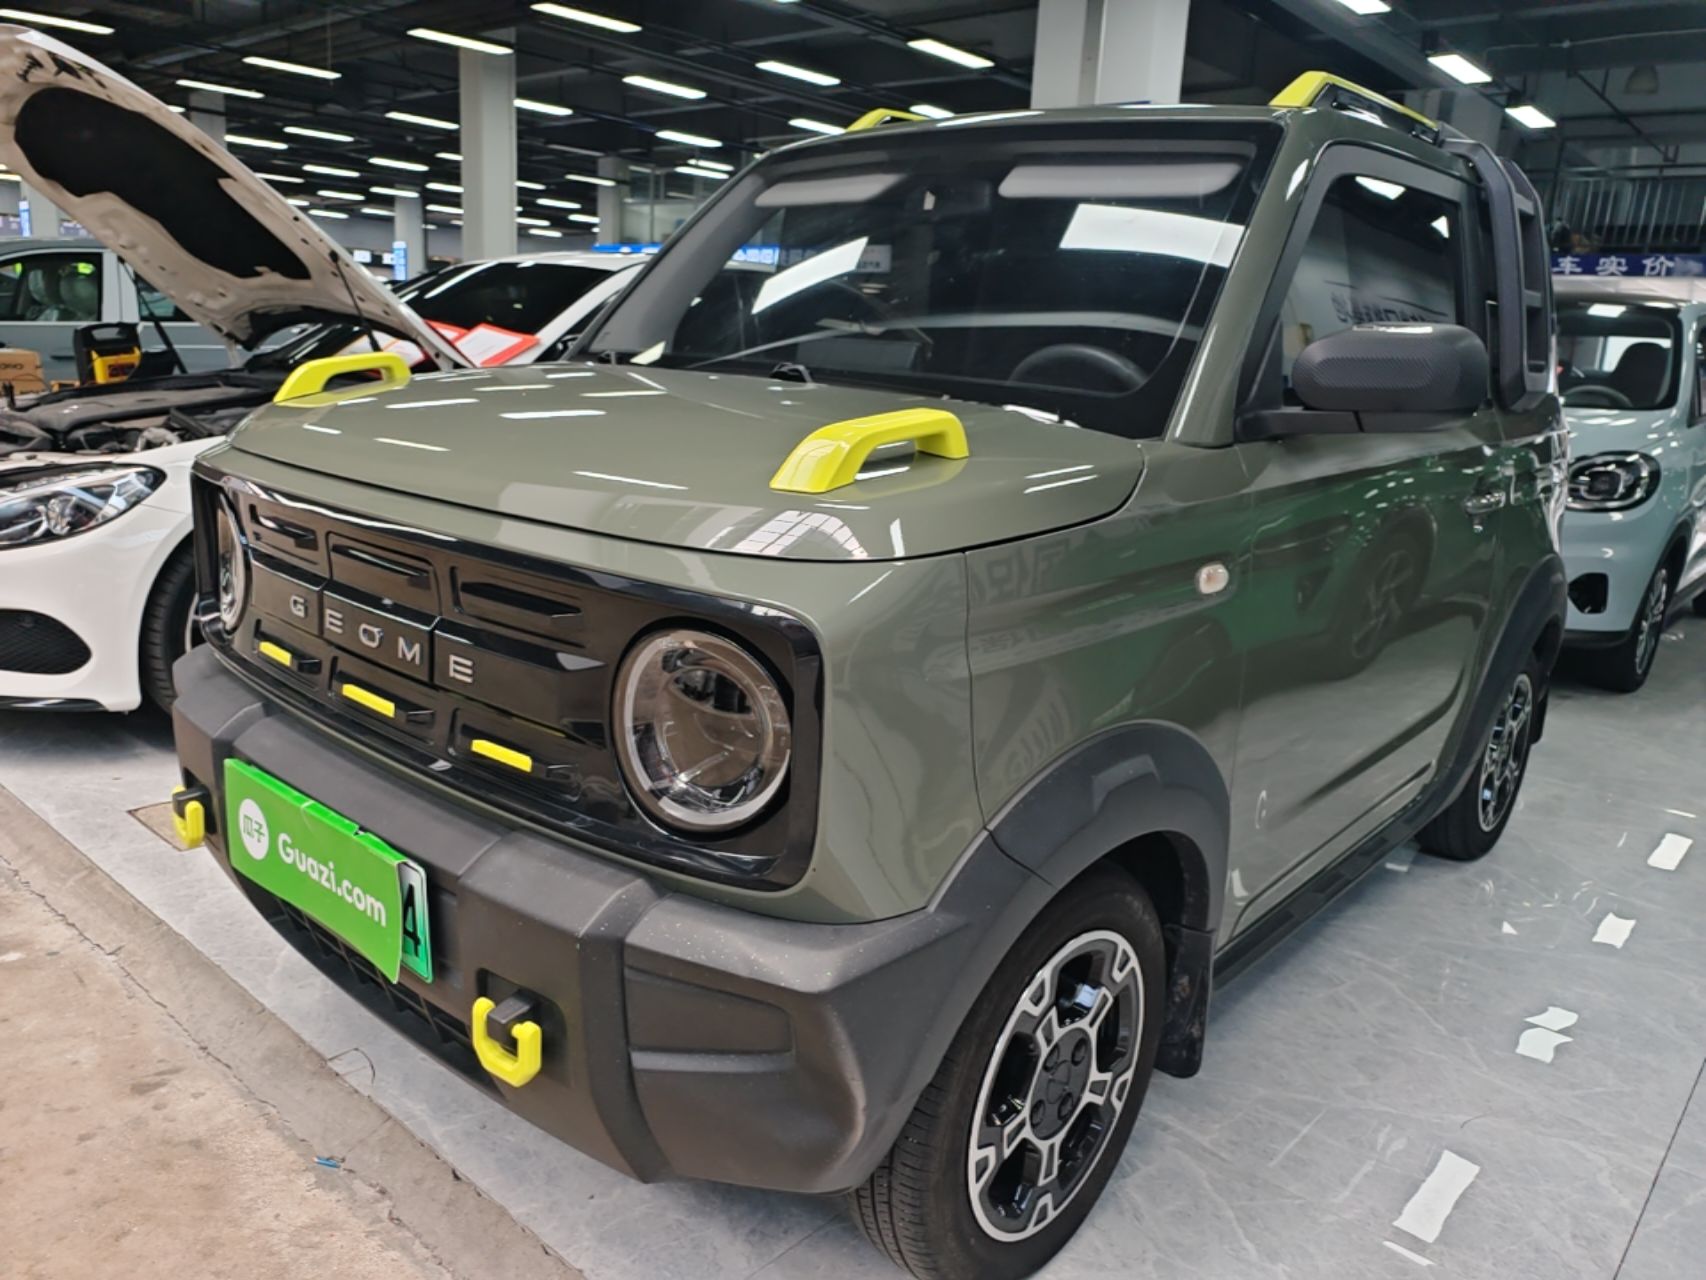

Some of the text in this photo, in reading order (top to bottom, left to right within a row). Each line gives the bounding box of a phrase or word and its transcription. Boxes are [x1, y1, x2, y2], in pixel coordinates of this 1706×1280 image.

[1551, 255, 1675, 276] 车实价
[289, 594, 474, 684] GEOME
[277, 832, 387, 928] Guazi.com
